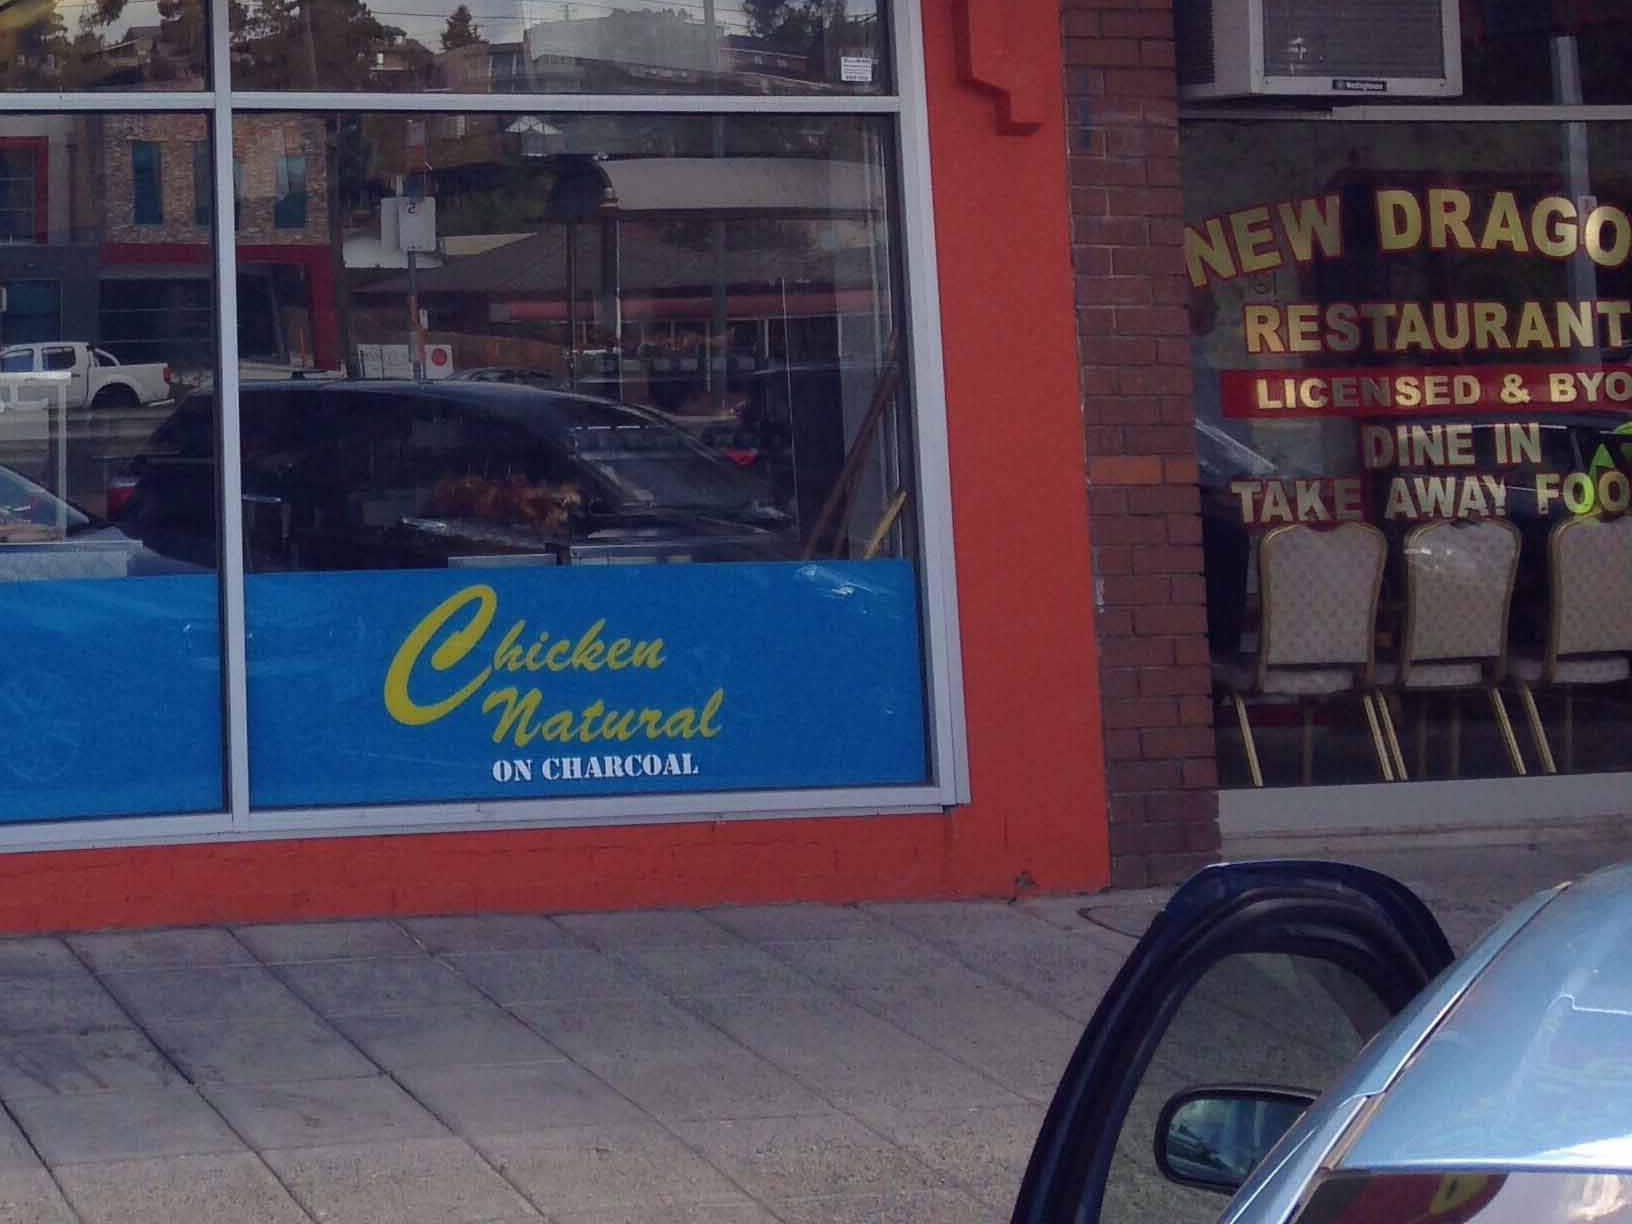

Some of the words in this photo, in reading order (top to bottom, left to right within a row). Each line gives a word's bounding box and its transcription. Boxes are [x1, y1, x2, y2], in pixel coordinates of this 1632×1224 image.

[1183, 192, 1343, 290] NEW
[1244, 301, 1632, 353] RESTAURANT
[1255, 373, 1481, 410] LICENSED
[1500, 373, 1531, 405] &
[1548, 371, 1632, 404] BYO
[1362, 423, 1476, 469] DINE
[1494, 422, 1542, 464] IN
[1230, 478, 1363, 523] TAKE
[1384, 475, 1507, 519] AWAY
[384, 584, 666, 727] Chicken
[481, 687, 726, 747] Natural
[492, 758, 533, 783] ON
[541, 752, 700, 779] CHARCOAL
